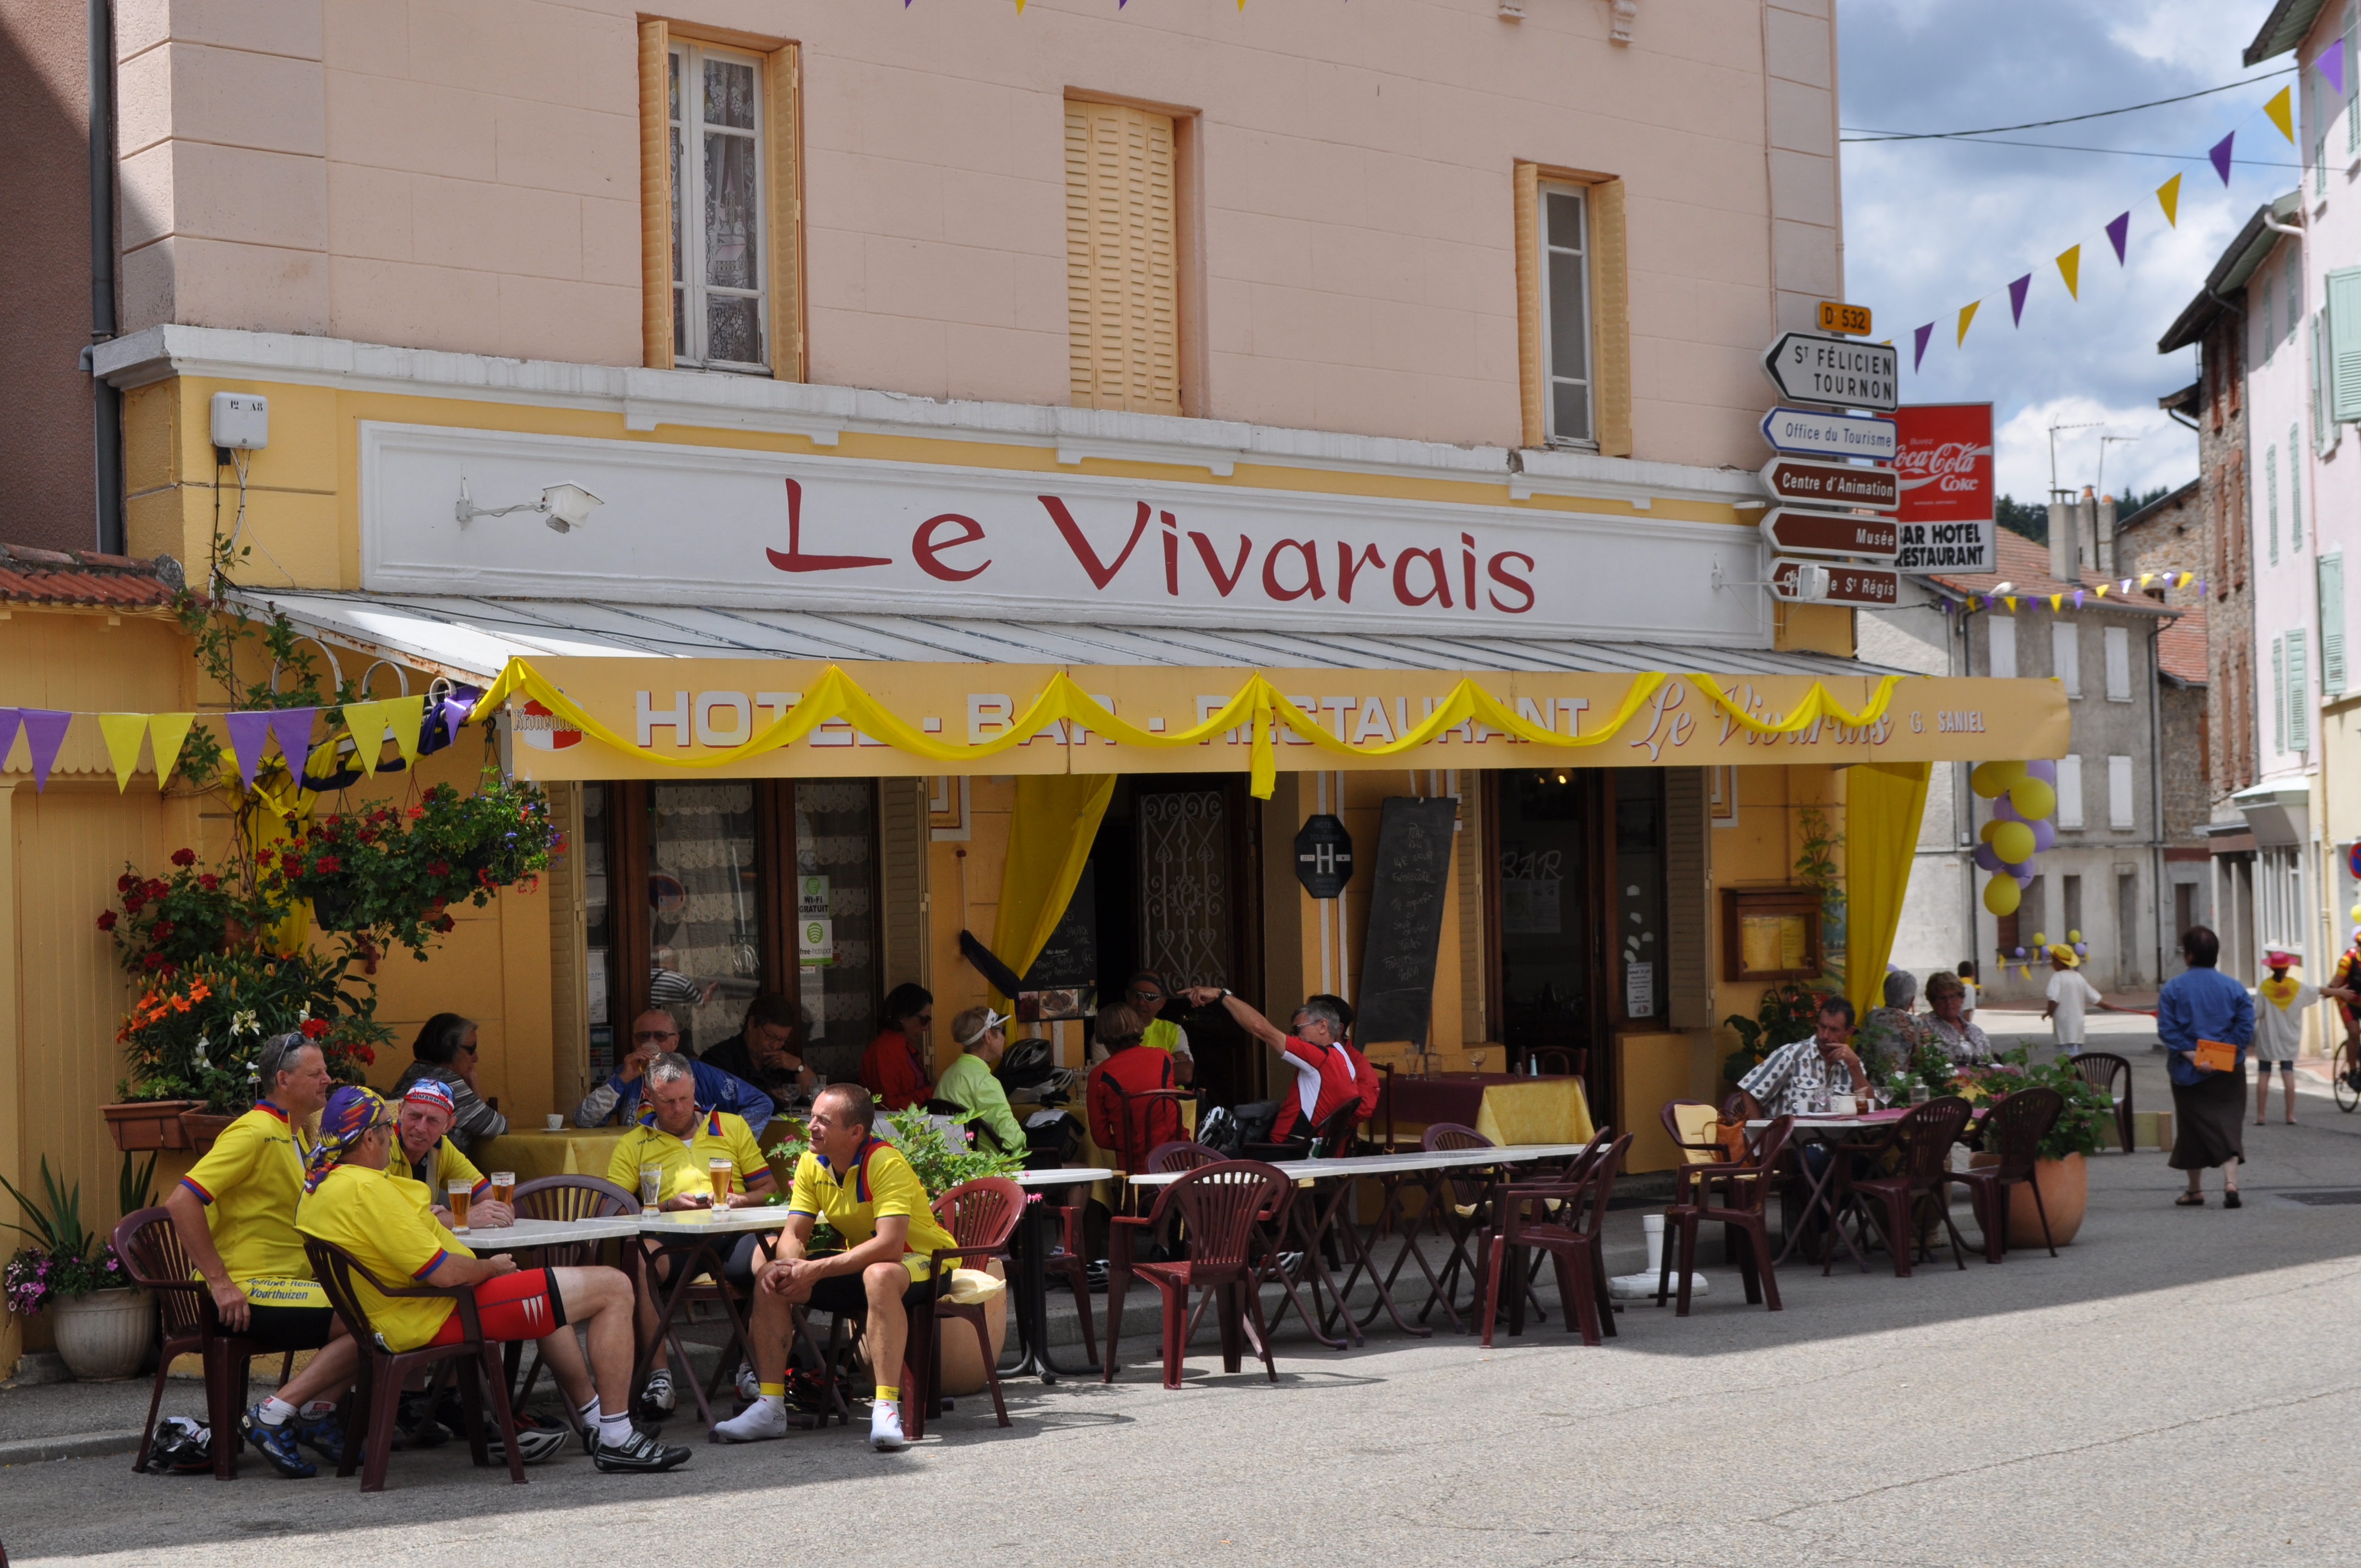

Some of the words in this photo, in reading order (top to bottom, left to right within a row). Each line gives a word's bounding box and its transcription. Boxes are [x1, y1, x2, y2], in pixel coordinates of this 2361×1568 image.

[1825, 306, 1834, 325] D
[1842, 309, 1866, 330] 532
[1817, 346, 1891, 376] FÉLICIEN
[1814, 373, 1892, 400] TOURNON
[1786, 422, 1820, 440] Office
[1825, 426, 1838, 442] du
[1844, 428, 1892, 447] Tourisme
[1782, 472, 1820, 491] Centre
[1826, 476, 1894, 497] d'Animation
[1940, 475, 1979, 492] Coke
[765, 477, 993, 582] Le
[1037, 494, 1535, 614] Vivarais
[1856, 527, 1894, 546] Musée
[1900, 525, 1925, 545] AR
[1932, 523, 1981, 544] HOTEL
[1862, 579, 1894, 598] Régis
[1630, 682, 1696, 762] Le
[1910, 712, 1926, 733] G.
[1938, 710, 1985, 733] SANIEL
[1315, 843, 1335, 874] H
[1500, 850, 1564, 880] BAR
[799, 905, 829, 913] GRATUIT
[250, 1287, 308, 1300] Voorthuizen
